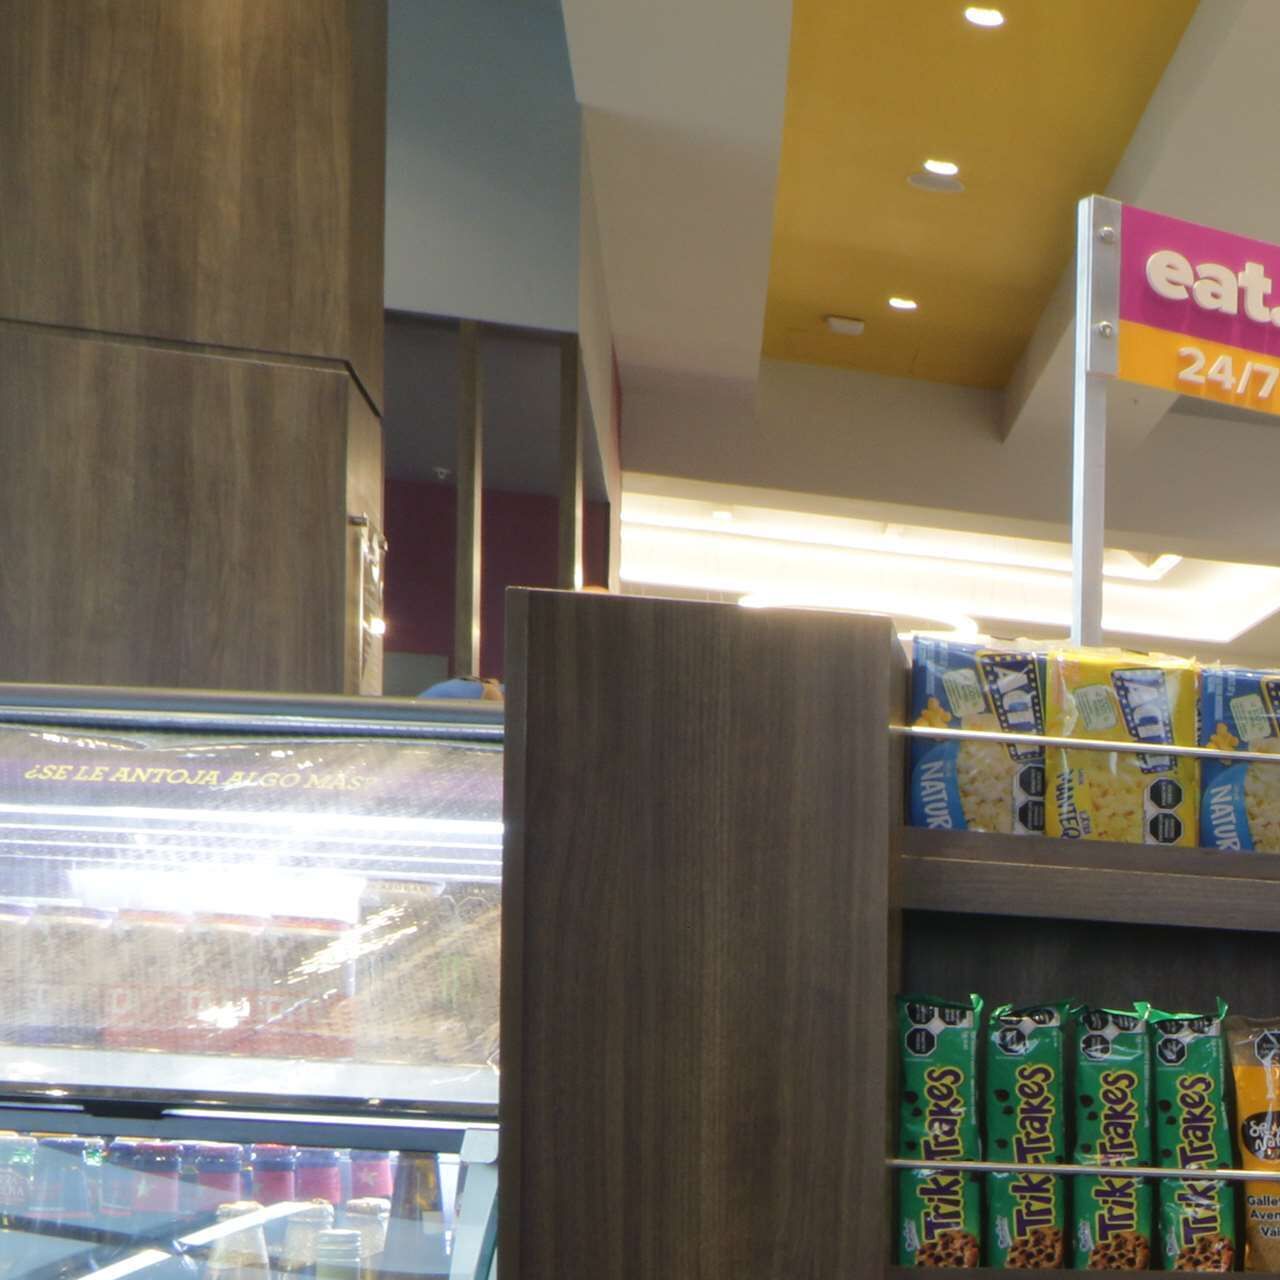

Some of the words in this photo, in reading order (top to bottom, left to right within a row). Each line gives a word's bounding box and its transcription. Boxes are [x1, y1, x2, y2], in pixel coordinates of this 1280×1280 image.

[1178, 346, 1280, 398] 24/7
[73, 766, 108, 783] LE
[109, 767, 218, 786] ANTOJA
[920, 1067, 963, 1241] TrikTrakes
[1011, 1066, 1053, 1239] Trik-Trakes
